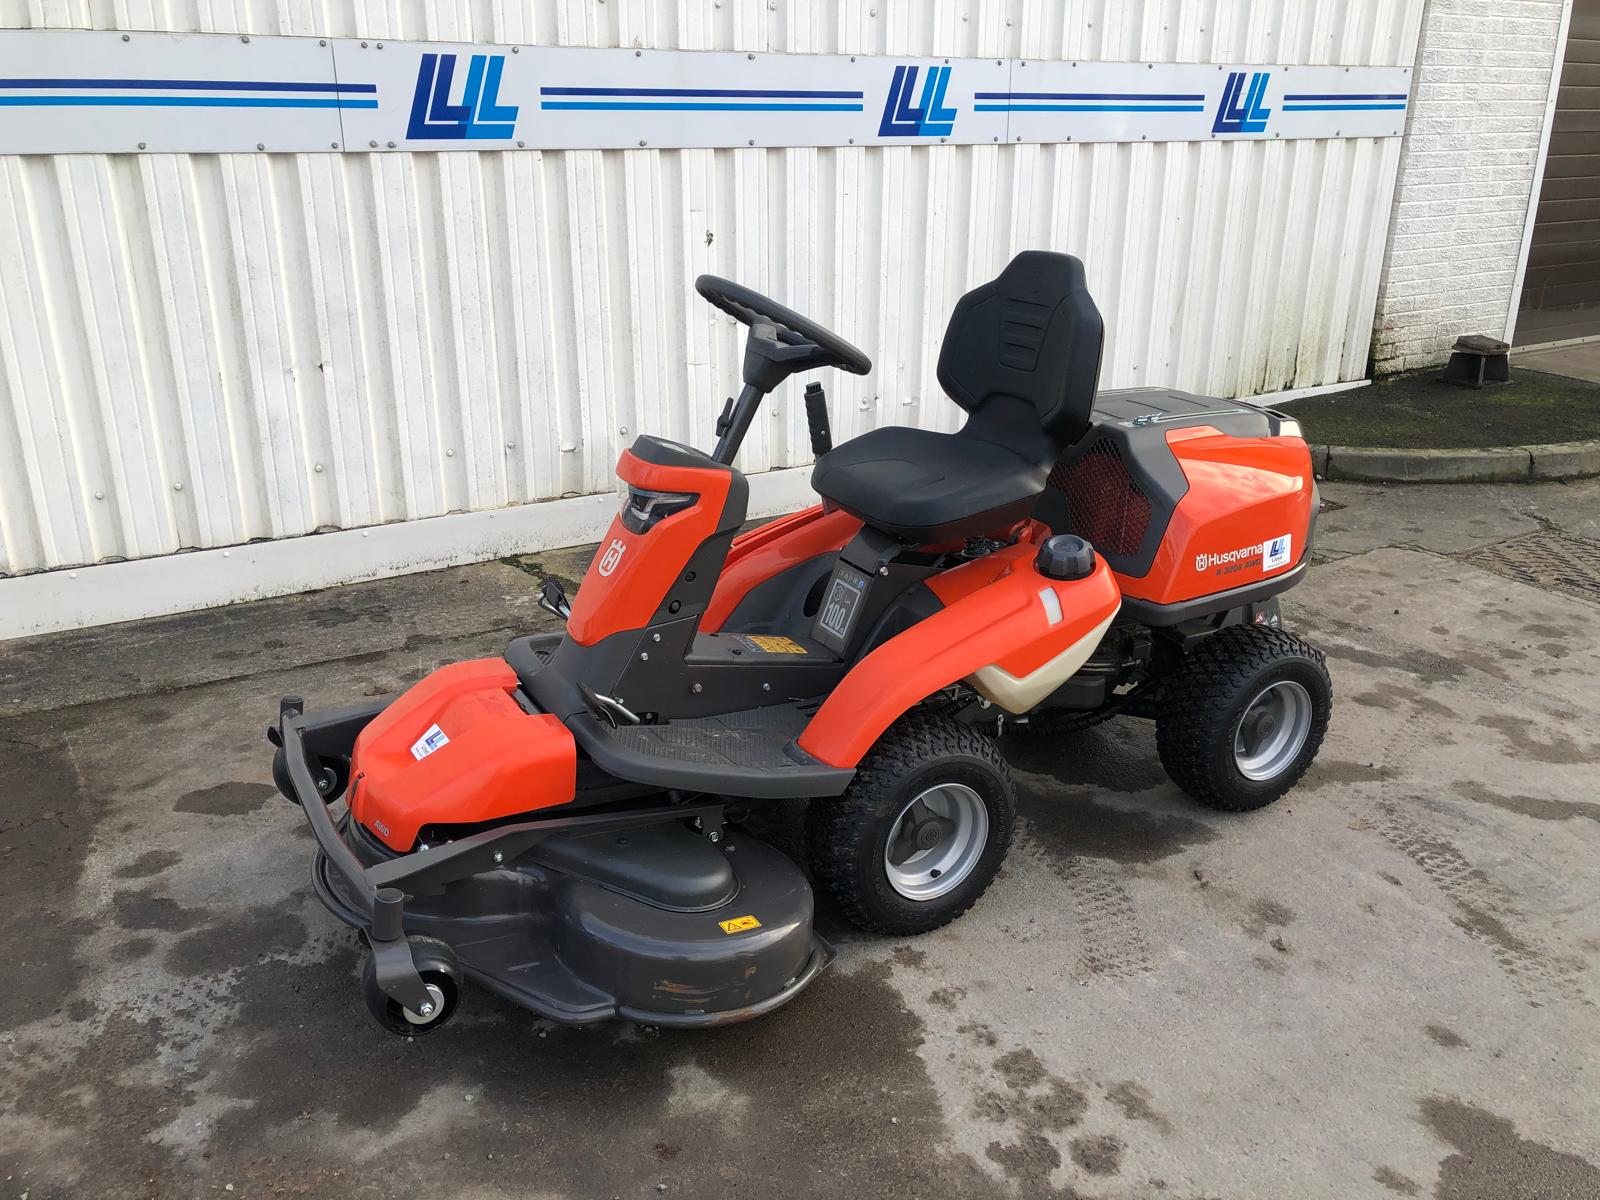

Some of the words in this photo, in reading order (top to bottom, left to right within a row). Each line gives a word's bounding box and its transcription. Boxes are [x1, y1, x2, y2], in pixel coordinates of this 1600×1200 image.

[1208, 543, 1263, 567] Husqvarna
[825, 602, 846, 631] 100
[374, 819, 390, 837] AWD
